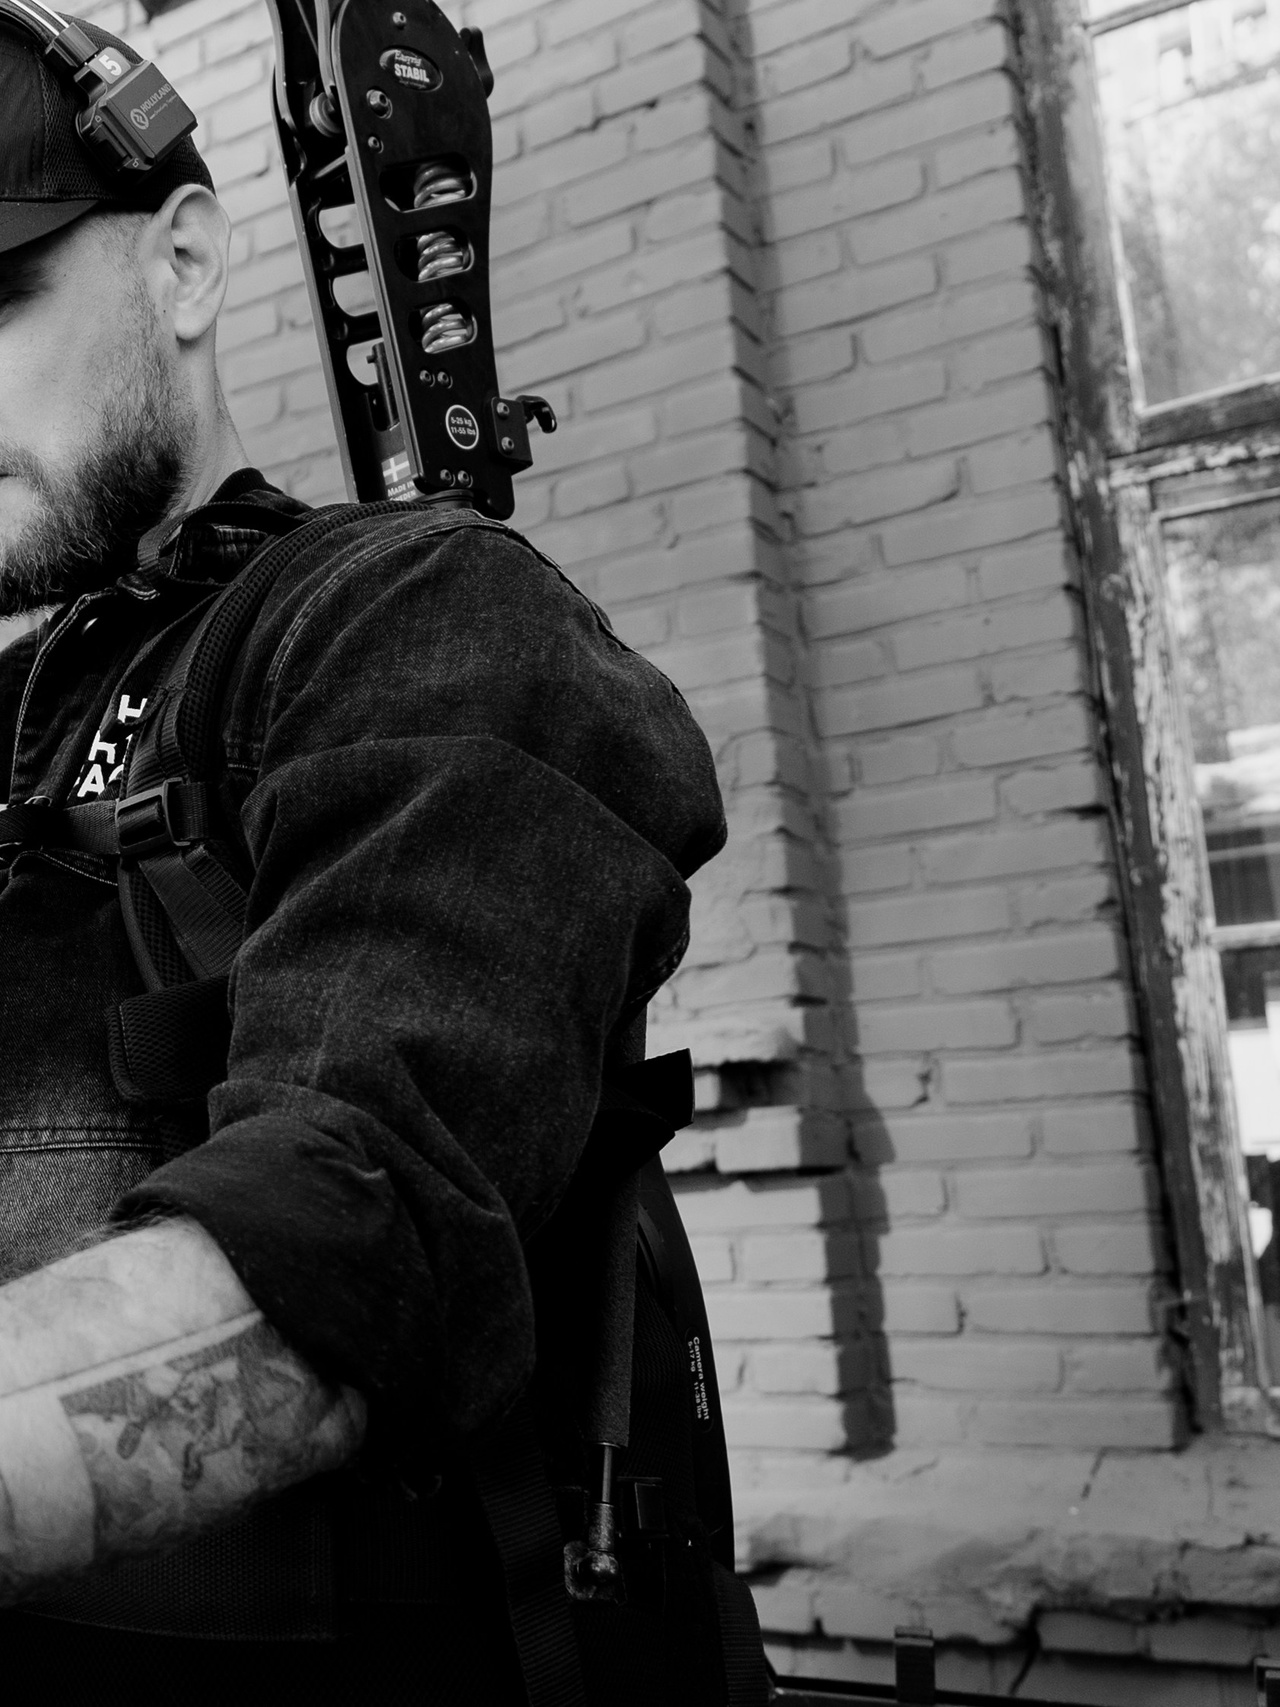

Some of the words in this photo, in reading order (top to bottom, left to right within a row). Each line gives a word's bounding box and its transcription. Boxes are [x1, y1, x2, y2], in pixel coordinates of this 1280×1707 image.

[98, 54, 122, 76] 5
[394, 63, 430, 83] STABIL
[139, 83, 172, 113] HOLLYLAND
[387, 484, 406, 497] MADE
[693, 1336, 704, 1380] Camera
[700, 1382, 710, 1420] weight
